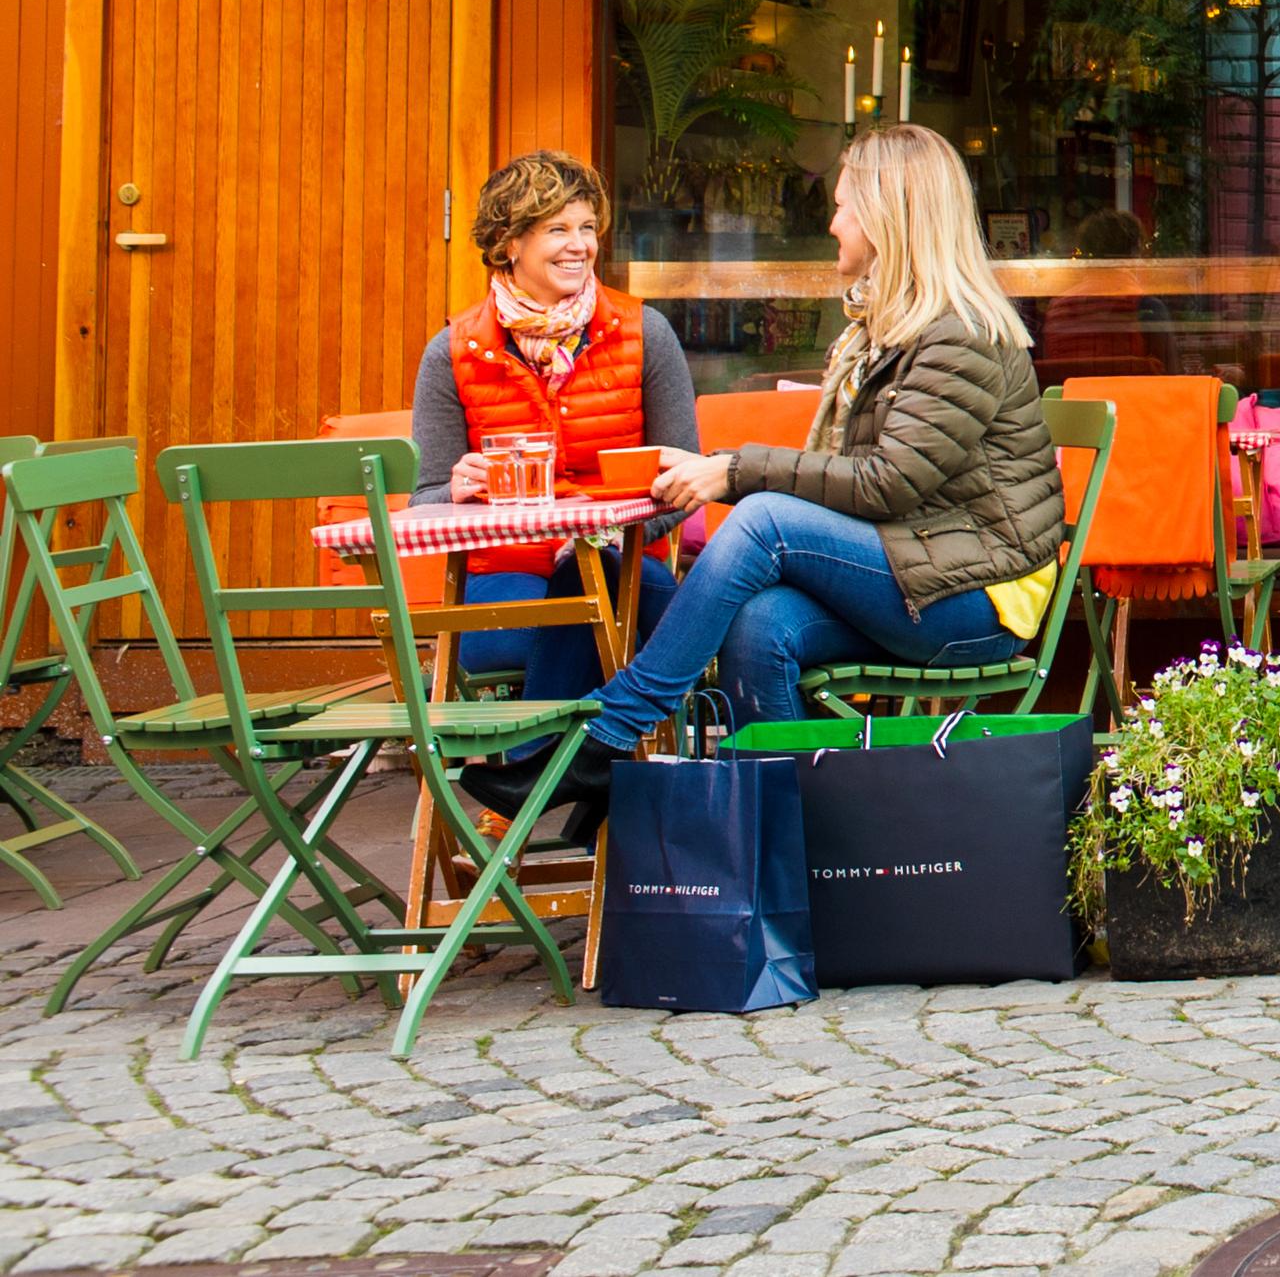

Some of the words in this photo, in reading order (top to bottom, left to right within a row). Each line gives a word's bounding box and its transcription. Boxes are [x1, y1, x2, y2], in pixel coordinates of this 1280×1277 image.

[811, 866, 871, 880] TOMMY
[893, 860, 964, 876] HILFIGER
[628, 884, 666, 895] TOMMY
[674, 884, 720, 897] HILFIGER
